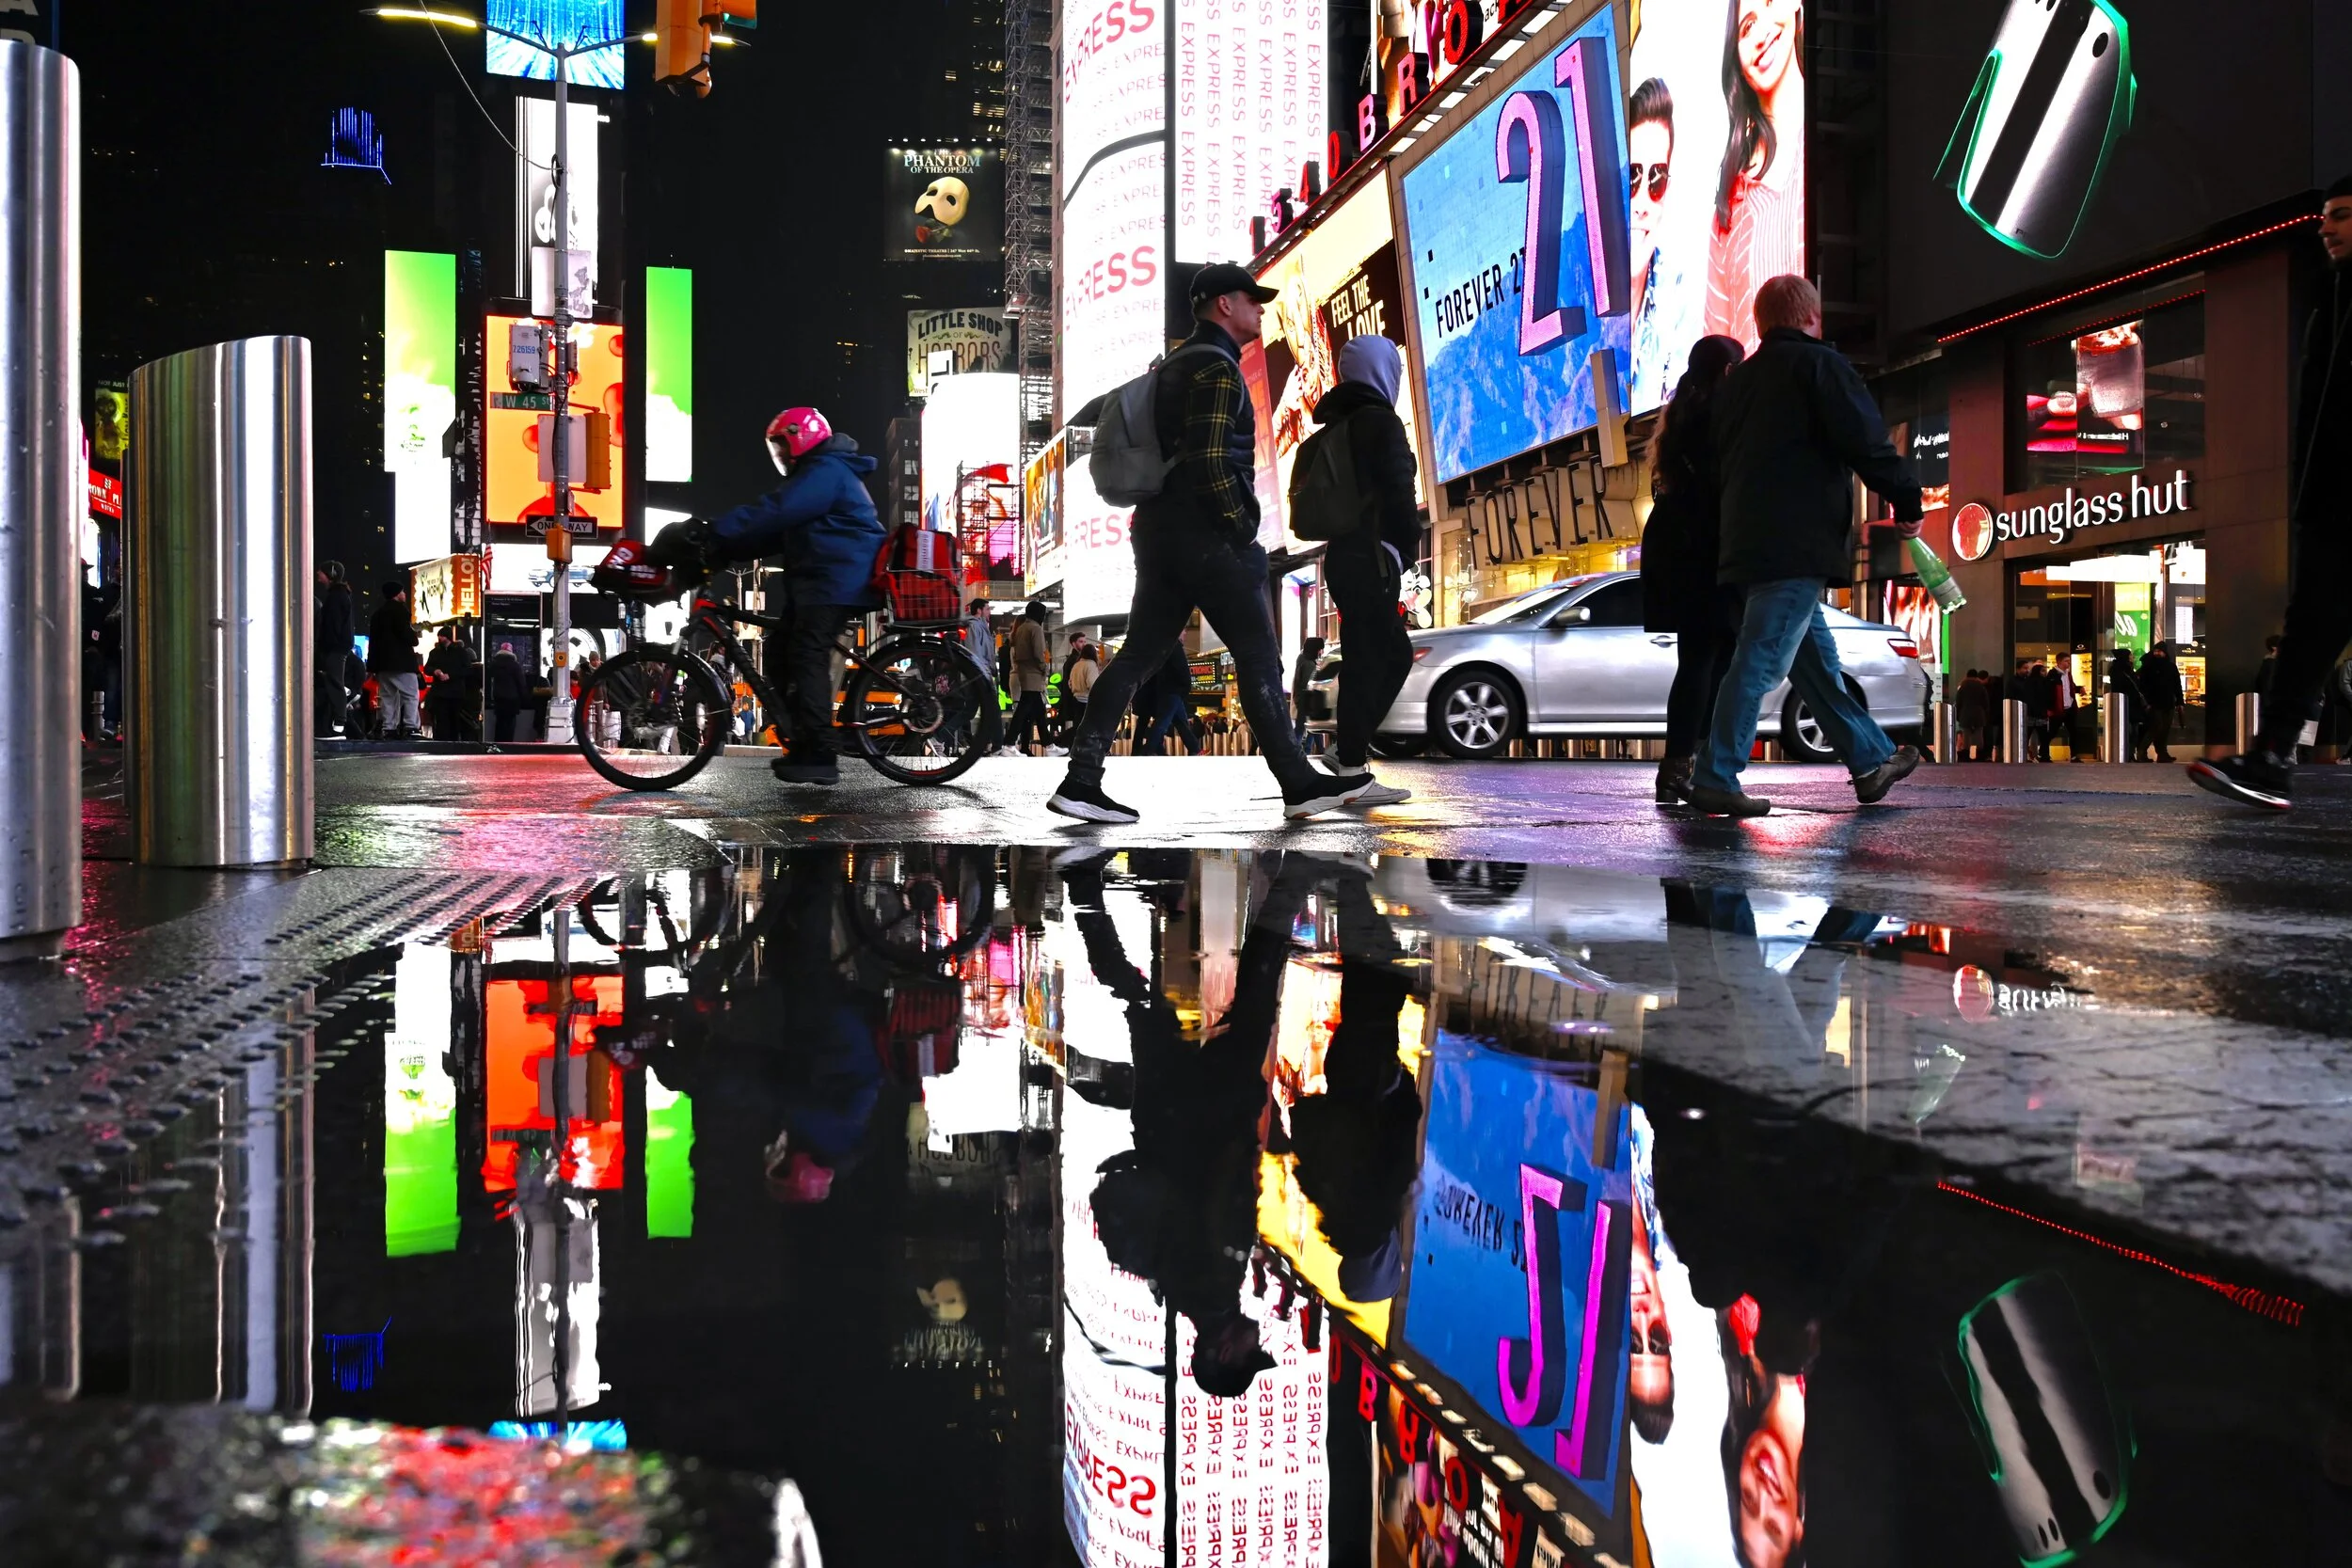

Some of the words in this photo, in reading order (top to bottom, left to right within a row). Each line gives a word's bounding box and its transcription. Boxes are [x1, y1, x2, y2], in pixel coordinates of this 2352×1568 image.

[1065, 0, 1155, 104] EXPRESS
[1181, 22, 1195, 117] EXPRESS
[1207, 34, 1220, 128] EXPRESS
[1232, 27, 1246, 121] EXPRESS
[1259, 39, 1272, 134] EXPRESS
[1283, 32, 1296, 126] EXPRESS
[1307, 43, 1321, 137] EXPRESS
[903, 154, 980, 166] PHANTOM
[1181, 131, 1195, 226] EXPRESS
[1207, 143, 1220, 237] EXPRESS
[1232, 135, 1246, 230] EXPRESS
[1496, 37, 1611, 356] 21
[918, 311, 965, 340] LITTLE
[968, 312, 1003, 337] SHOP
[1330, 289, 1354, 328] FEEL
[1351, 274, 1372, 313] THE
[1435, 263, 1505, 339] FOREVER
[513, 344, 536, 355] 726159
[918, 341, 1001, 387] HRORS
[505, 399, 516, 408] W
[522, 396, 536, 409] 45
[1466, 454, 1613, 570] FOREVER
[1996, 487, 2122, 545] sunglass
[2131, 469, 2192, 519] hut
[460, 557, 475, 614] HELLO!
